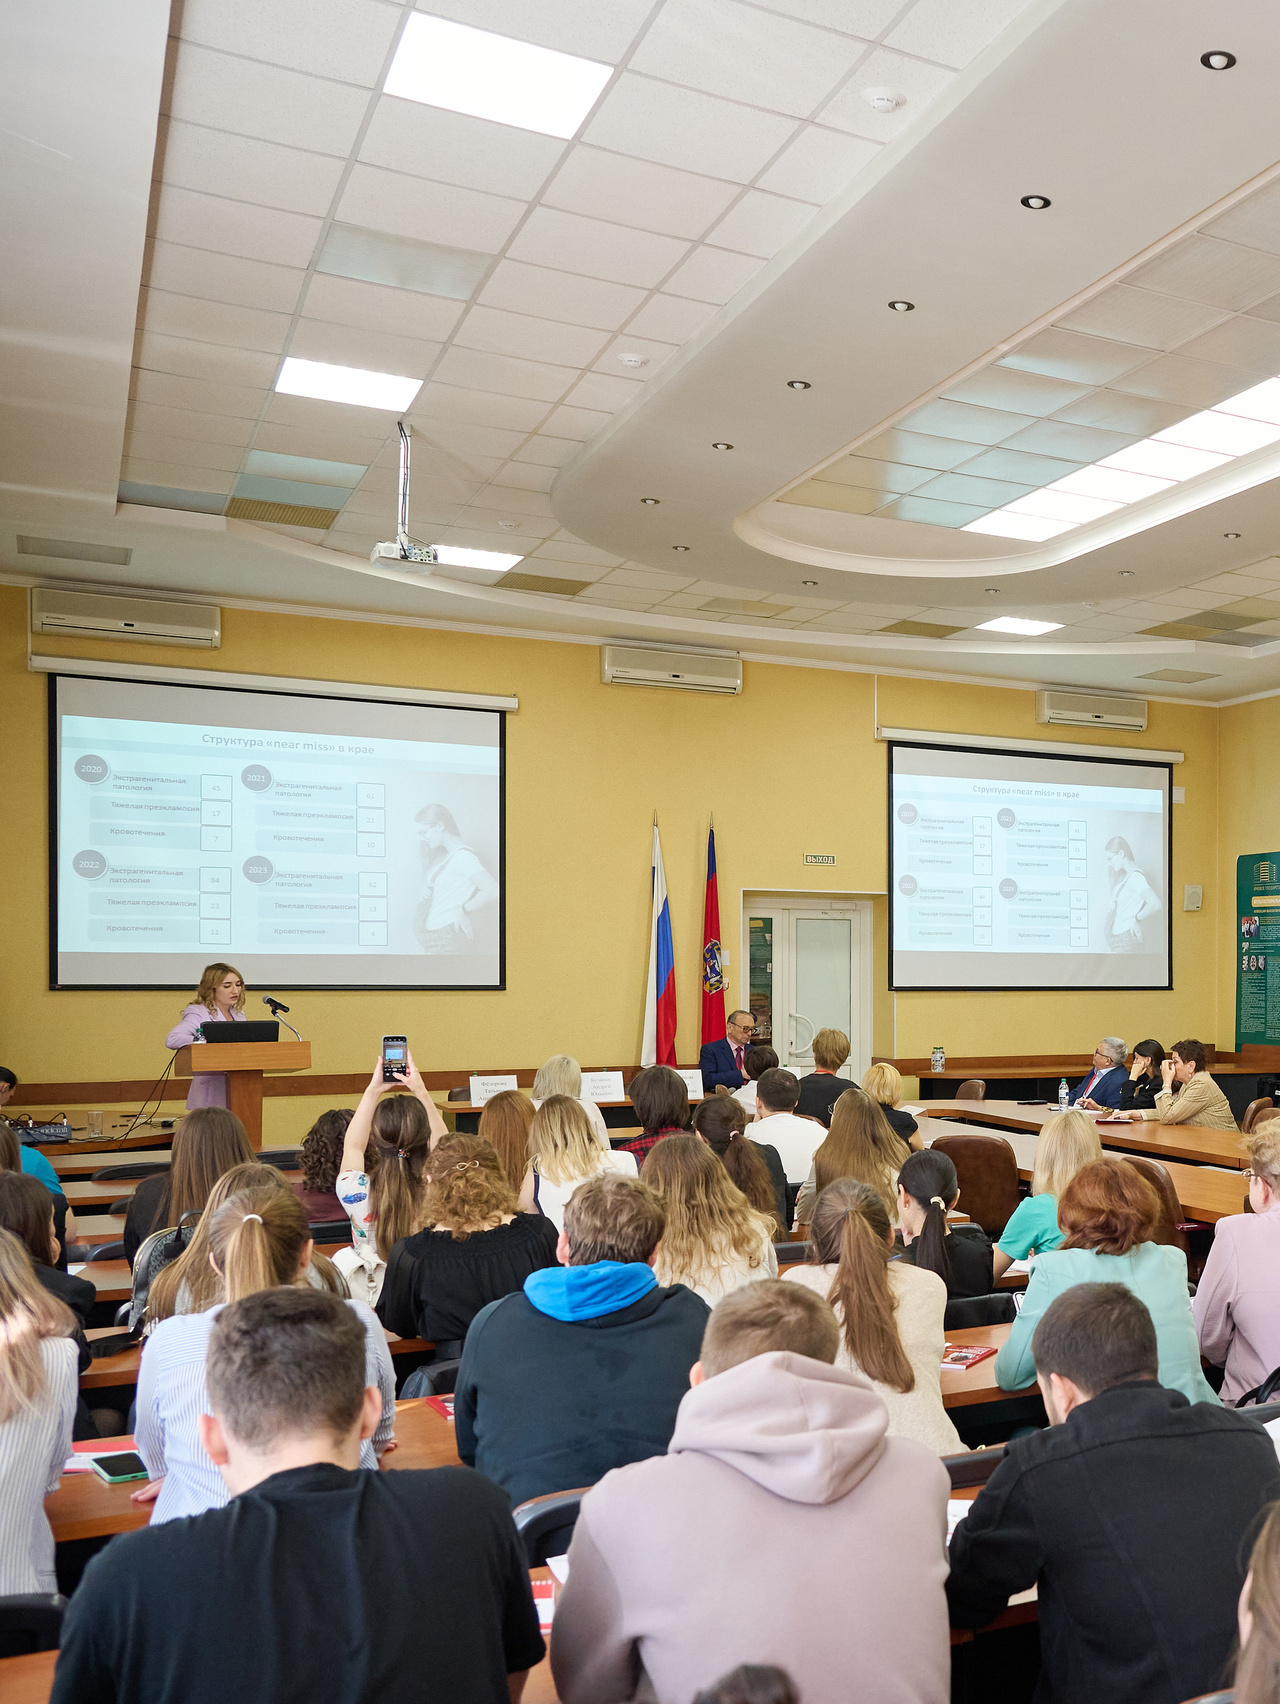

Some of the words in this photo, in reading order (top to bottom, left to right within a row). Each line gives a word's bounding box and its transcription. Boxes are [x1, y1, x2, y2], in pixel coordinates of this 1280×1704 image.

[202, 734, 263, 748] Структура
[266, 740, 301, 750] «near
[303, 742, 335, 752] miss»
[348, 746, 375, 755] крае
[80, 764, 102, 773] 2020
[113, 774, 186, 784] Экстрагенитальная
[246, 774, 266, 782] 2021
[112, 784, 153, 792] патология
[274, 782, 343, 791] Экстрагенитальная
[972, 785, 1011, 795] Структура
[1062, 791, 1080, 799] крае
[110, 801, 143, 810] Тяжелая
[144, 804, 200, 813] преэклампсия
[272, 810, 302, 818] Тяжелая
[302, 812, 354, 820] преэклампсия
[110, 828, 166, 837] Кровотечения
[273, 834, 324, 842] Кровотечения
[806, 855, 834, 864] ВЫХОД
[79, 860, 100, 869] 2022
[109, 868, 184, 877] Экстрагенитальная
[248, 866, 268, 874] 2023
[275, 872, 343, 880] Экстрагенитальная
[107, 898, 141, 906] Тяжелая
[141, 900, 197, 908] преэклампсия
[274, 902, 304, 910] Тяжелая
[106, 925, 163, 933] Кровотечения
